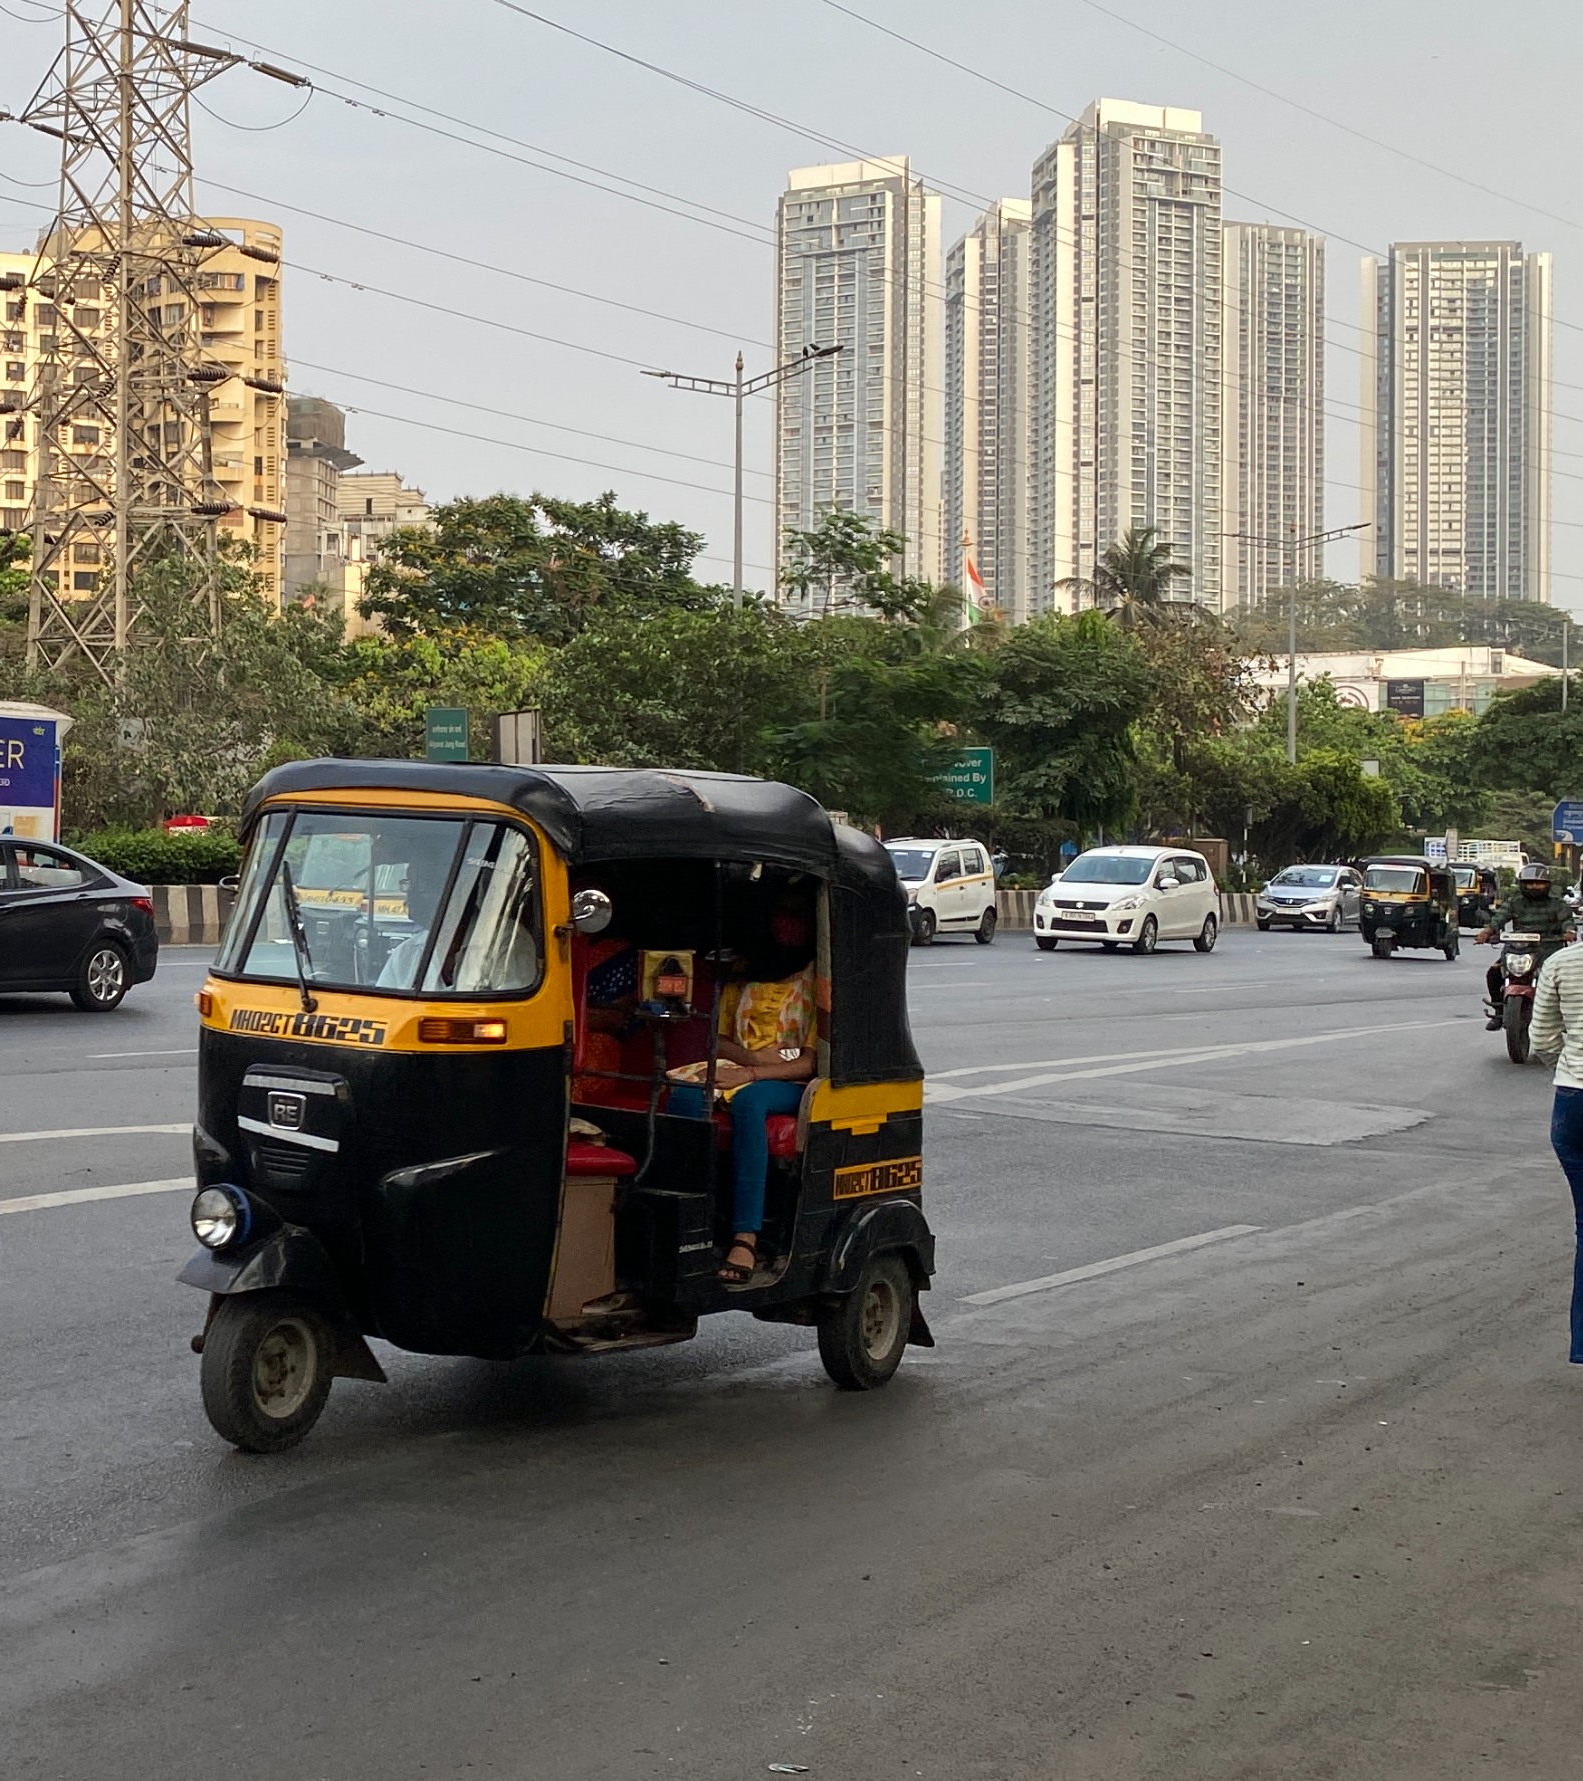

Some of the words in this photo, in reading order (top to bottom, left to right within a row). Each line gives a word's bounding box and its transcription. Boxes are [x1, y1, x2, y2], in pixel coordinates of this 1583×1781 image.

[455, 740, 466, 748] Road
[972, 773, 987, 784] By
[274, 1103, 298, 1122] RE
